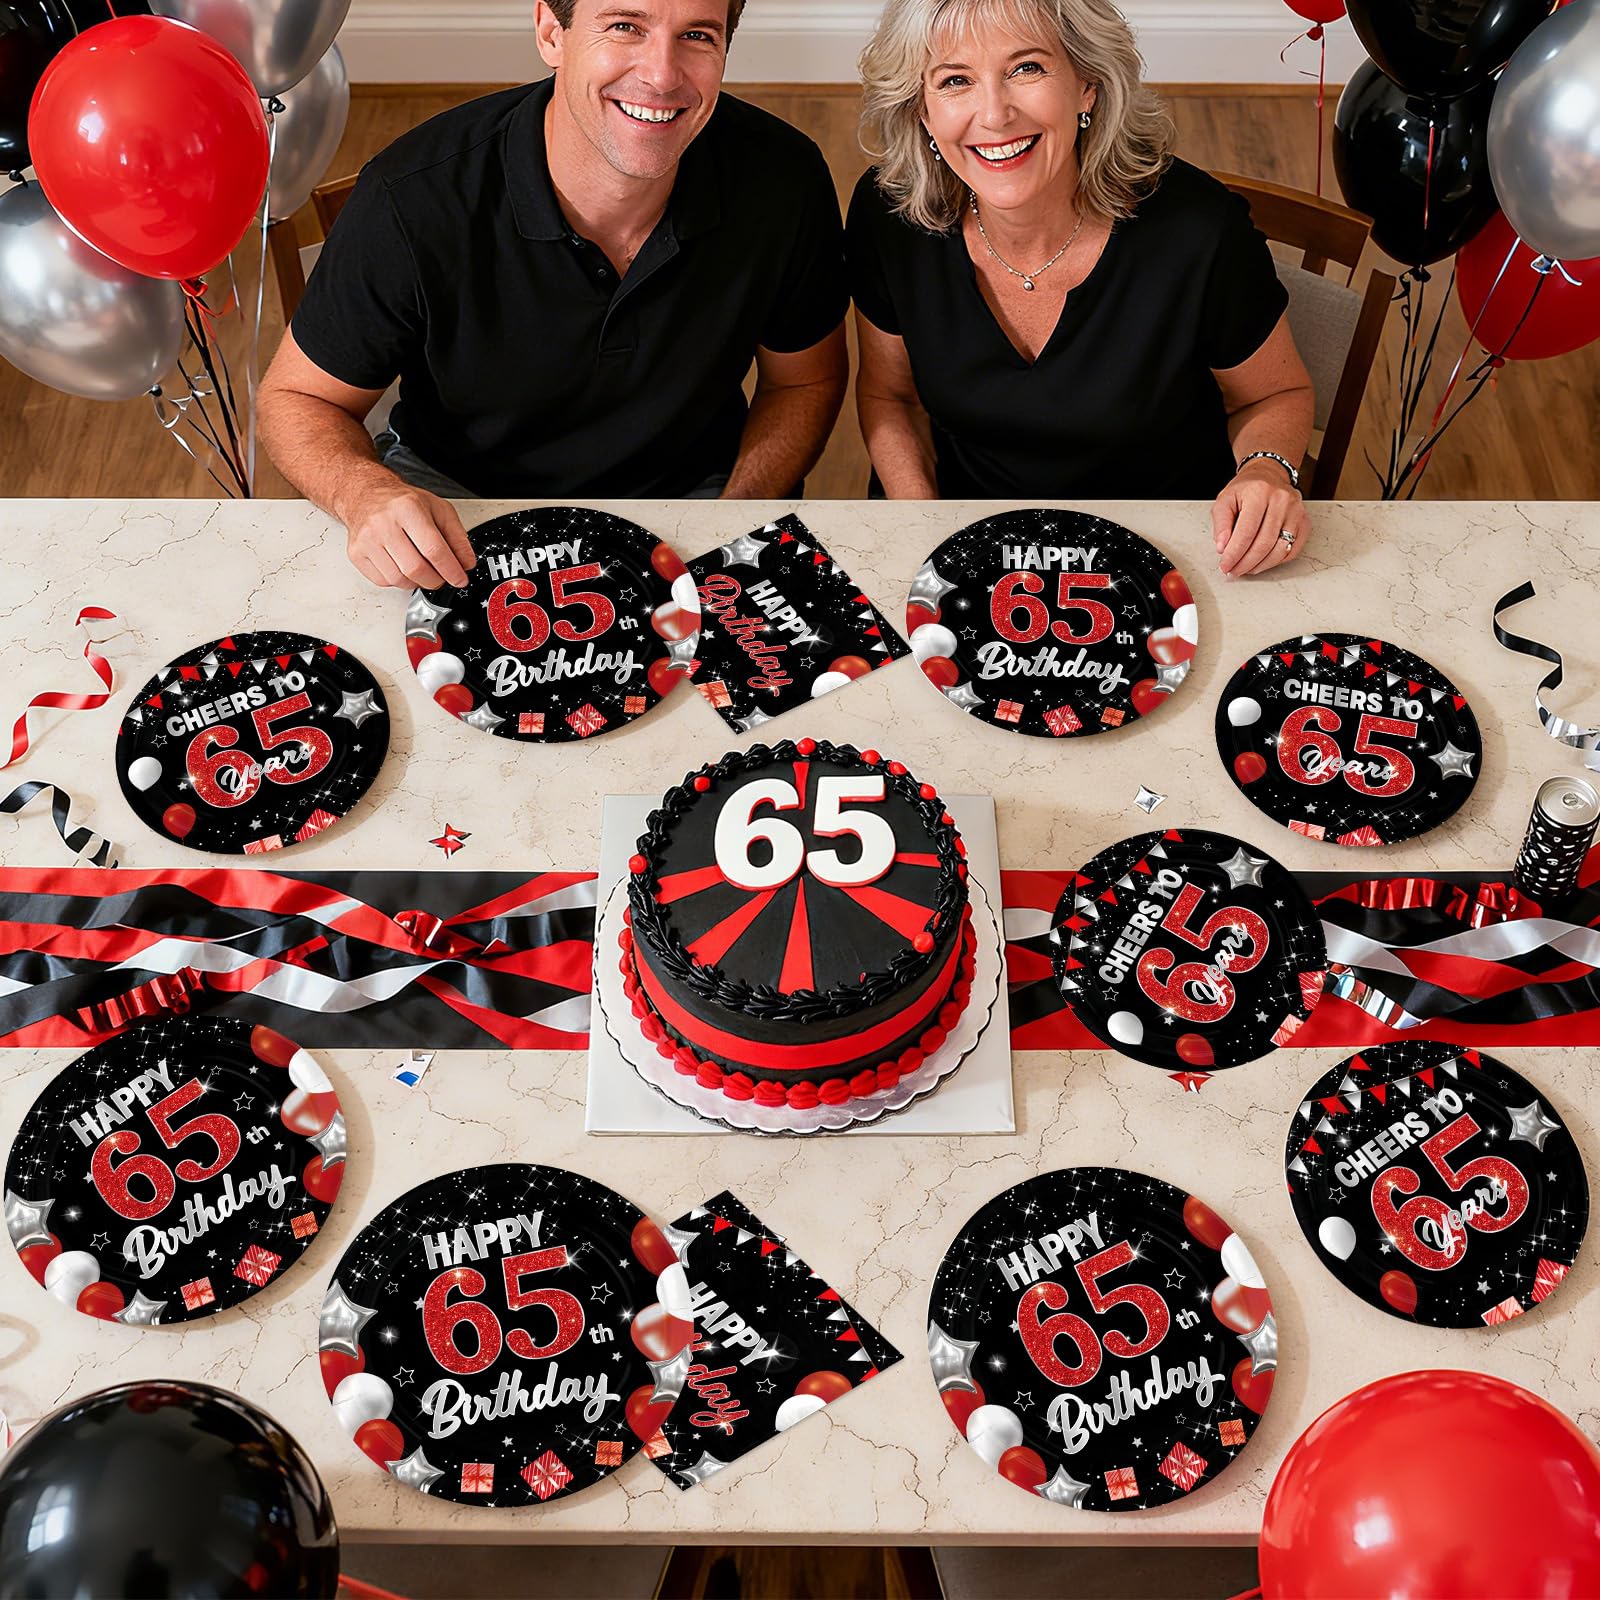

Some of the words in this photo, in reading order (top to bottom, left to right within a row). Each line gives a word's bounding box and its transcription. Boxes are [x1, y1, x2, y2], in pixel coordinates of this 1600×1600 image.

[487, 538, 582, 581] HAPPY
[1002, 545, 1099, 572] HAPPY
[696, 574, 793, 697] Birthday
[745, 579, 819, 646] HAPPY
[166, 685, 267, 737] CHEERS
[268, 671, 306, 698] TO
[486, 642, 644, 697] Birthday
[977, 641, 1130, 694] Birthday
[1283, 678, 1383, 713] CHEERS
[1390, 696, 1424, 720] TO
[186, 691, 333, 808] 65
[221, 745, 316, 800] Years
[1276, 705, 1418, 797] 65
[1302, 749, 1399, 780] Years
[714, 775, 896, 891] 65
[1098, 900, 1164, 984] CHEERS
[1147, 869, 1183, 900] TO
[1136, 882, 1270, 1023] 65
[1191, 923, 1248, 1006] Years
[69, 1057, 175, 1147] HAPPY
[1334, 1111, 1430, 1187] CHEERS
[1421, 1088, 1464, 1124] TO
[122, 1164, 297, 1279] Birthday
[1371, 1112, 1529, 1271] 65
[1422, 1179, 1508, 1258] Years
[422, 1209, 545, 1270] HAPPY
[996, 1211, 1105, 1292] HAPPY
[421, 1361, 621, 1440] Birthday
[1047, 1354, 1226, 1454] Birthday
